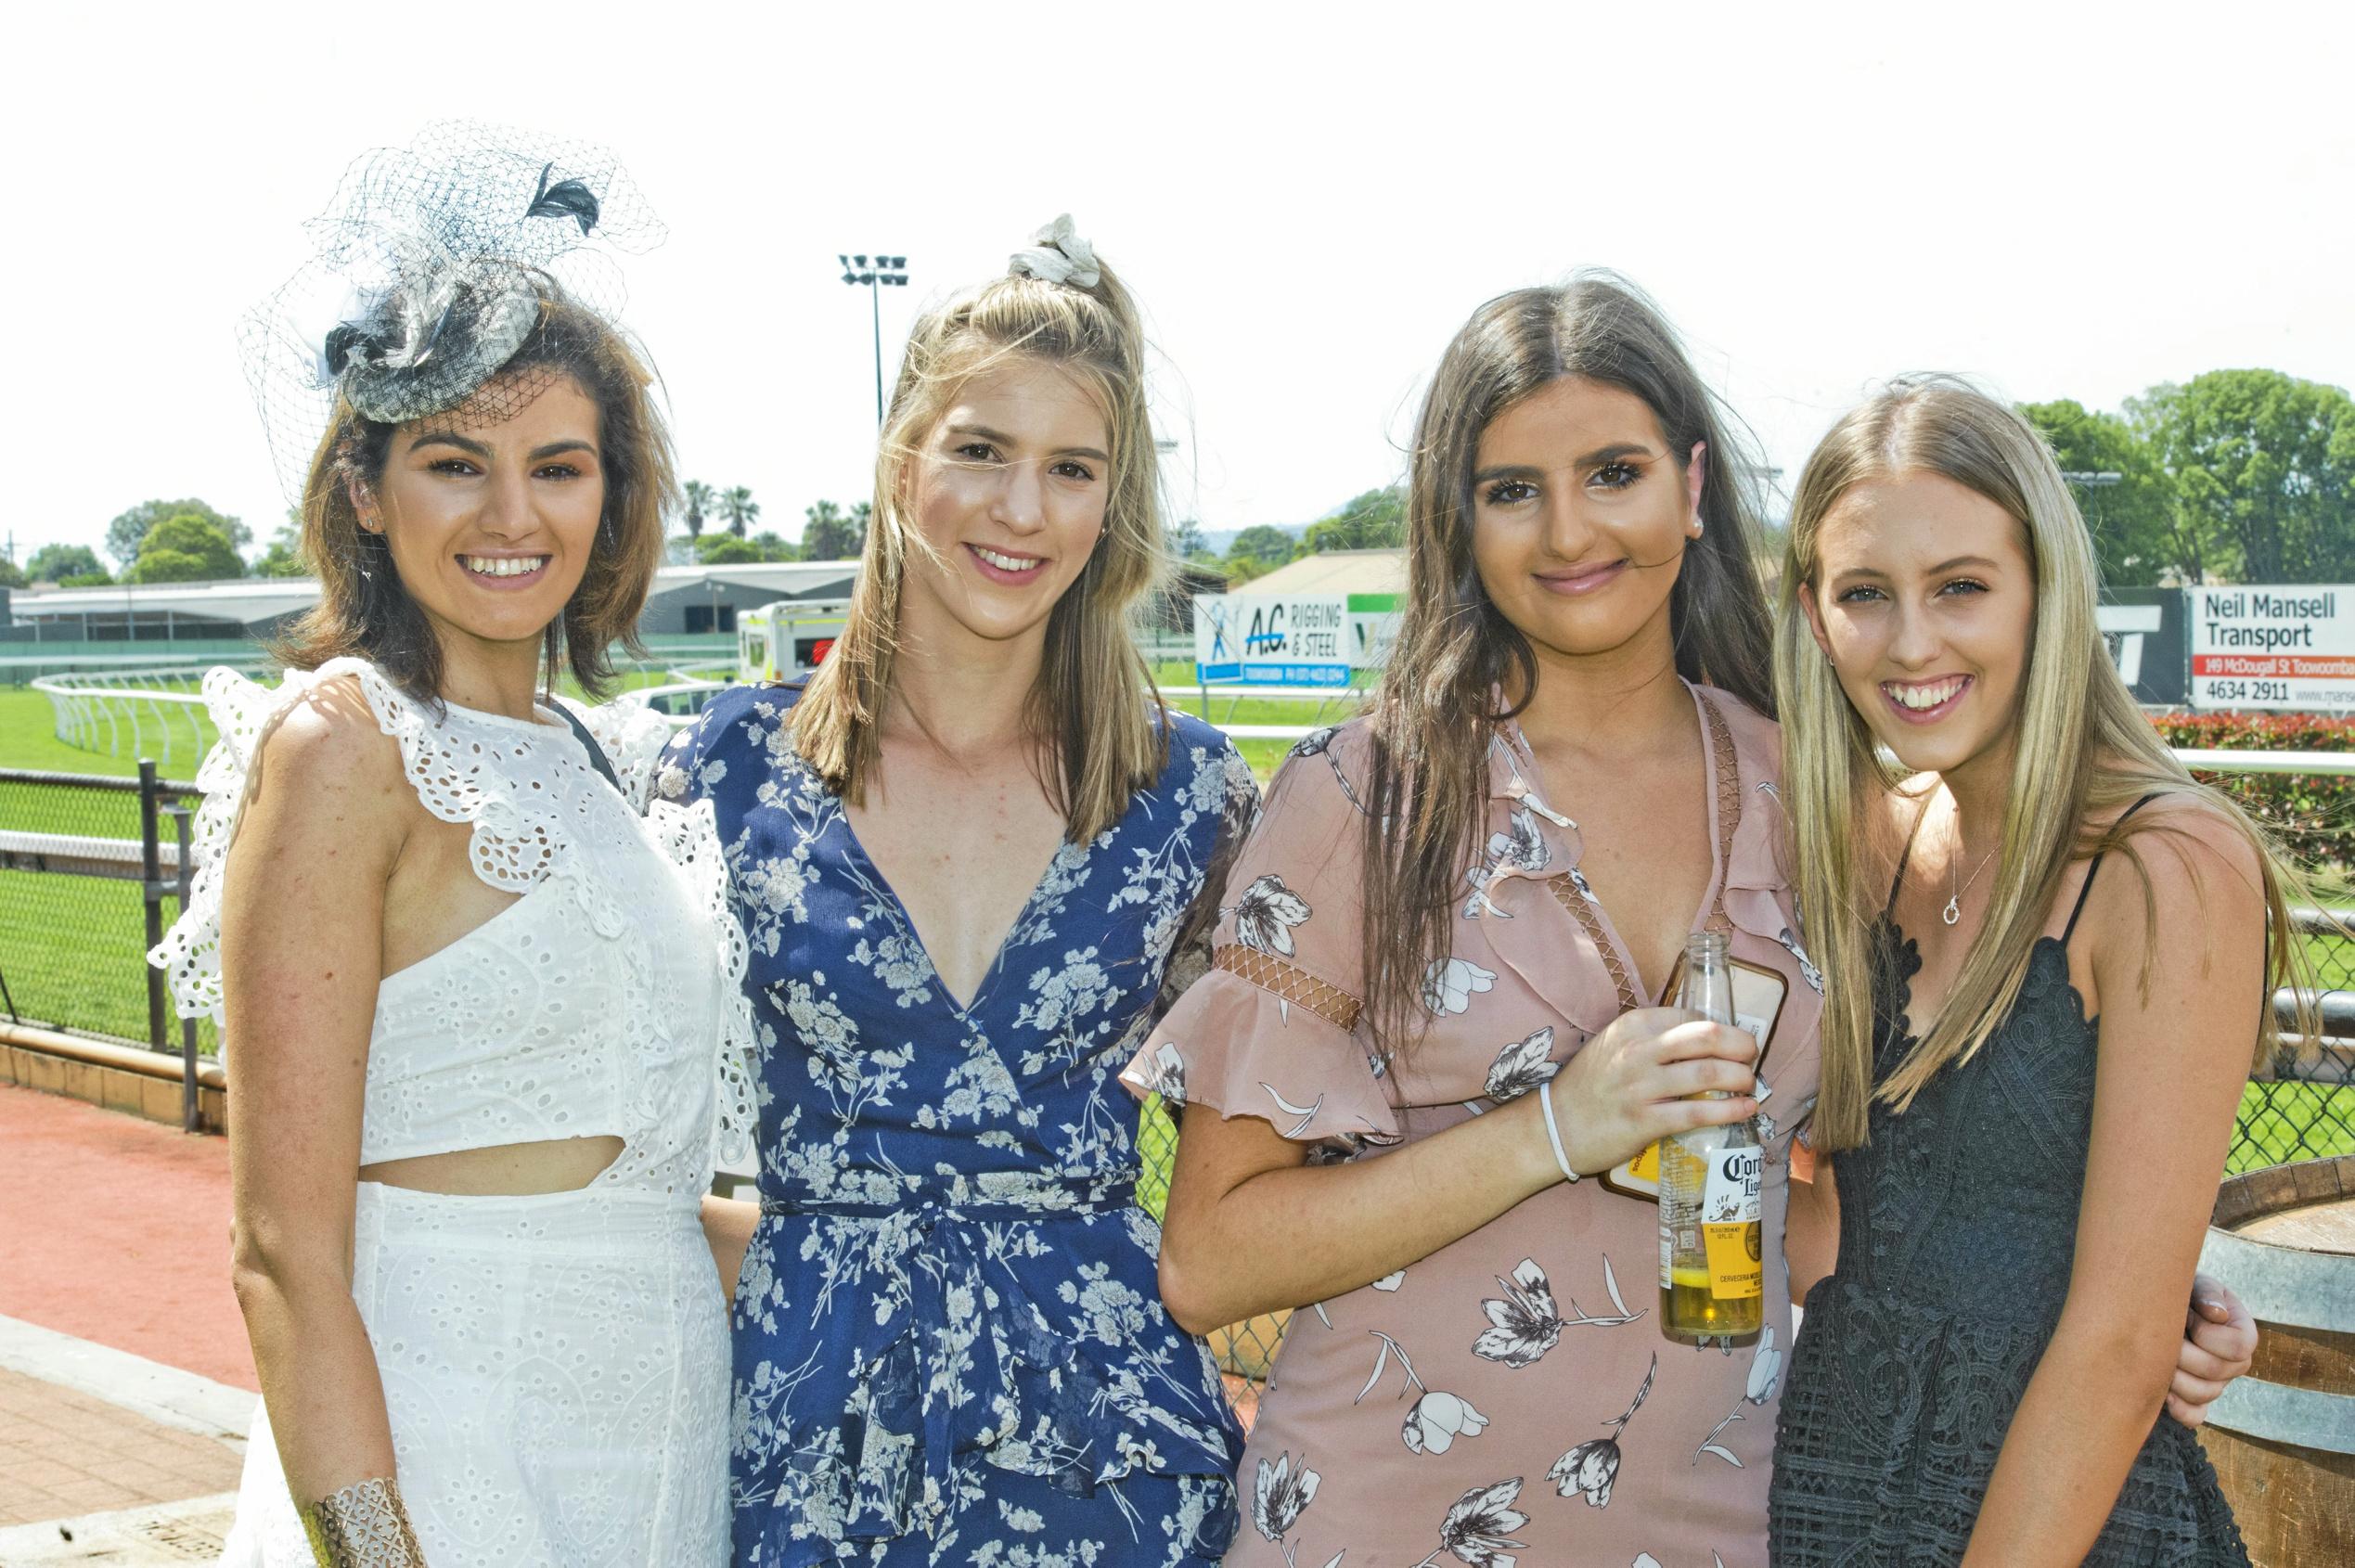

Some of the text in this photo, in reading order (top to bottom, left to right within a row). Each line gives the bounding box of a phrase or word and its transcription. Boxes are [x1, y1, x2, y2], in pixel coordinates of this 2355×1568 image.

[1291, 604, 1341, 628] RIGGING
[2206, 592, 2335, 618] Neil Mansell
[1292, 633, 1337, 657] & STEEL
[2206, 623, 2311, 652] Transport
[2279, 659, 2291, 675] St
[2292, 658, 2355, 675] Toowoomba
[2207, 681, 2246, 700] 4634
[2252, 681, 2289, 700] 2911
